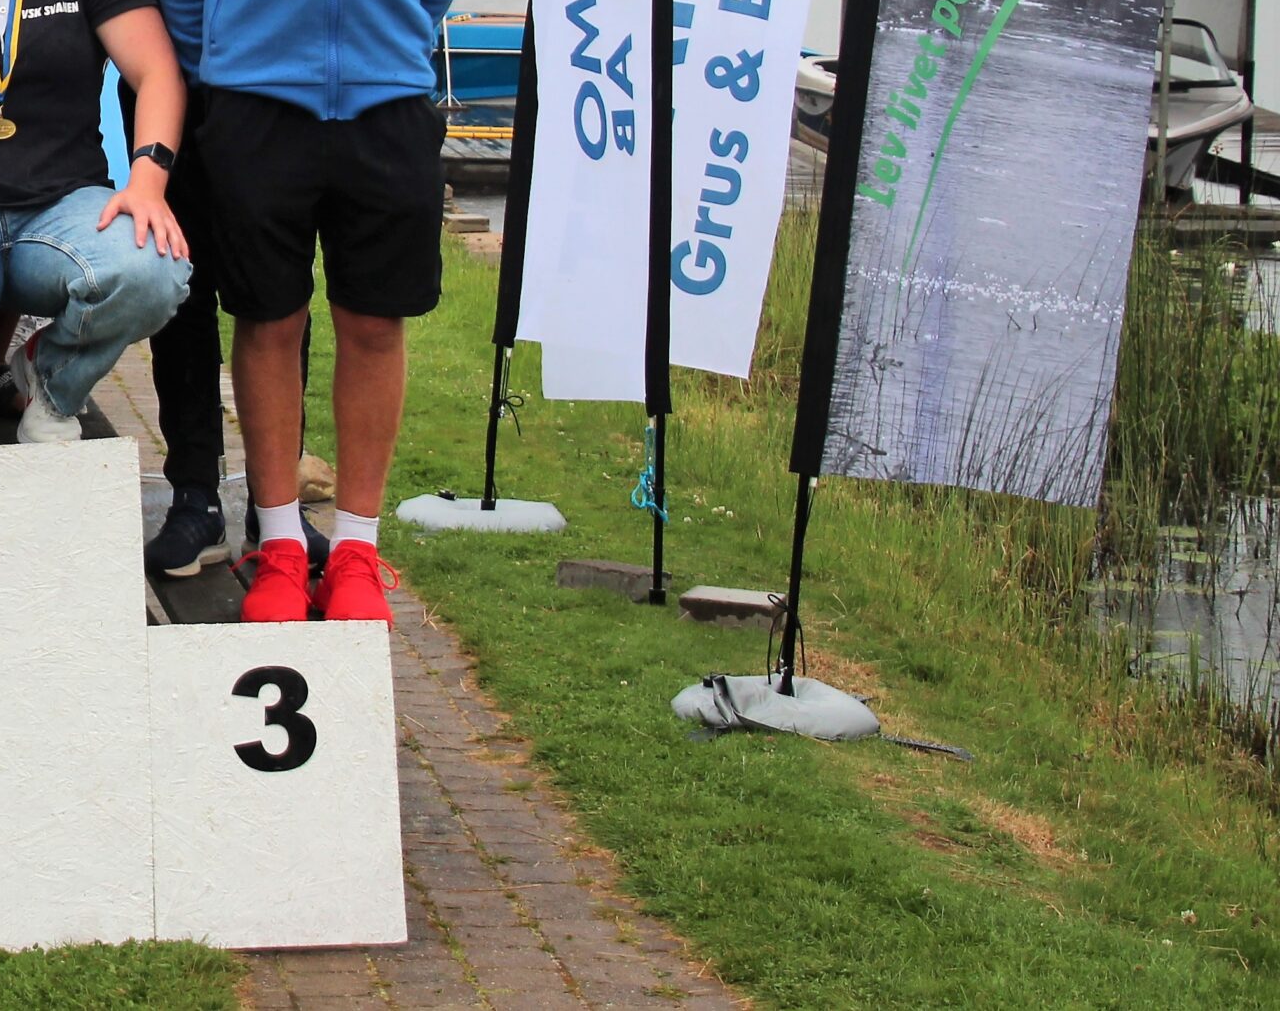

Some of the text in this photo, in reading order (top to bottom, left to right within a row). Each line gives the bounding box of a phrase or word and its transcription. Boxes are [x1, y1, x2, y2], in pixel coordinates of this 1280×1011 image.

[21, 6, 43, 19] VSK
[704, 48, 764, 102] &
[858, 130, 908, 210] Lev
[885, 31, 947, 130] livet
[670, 127, 749, 296] Grus
[231, 665, 318, 773] 3
